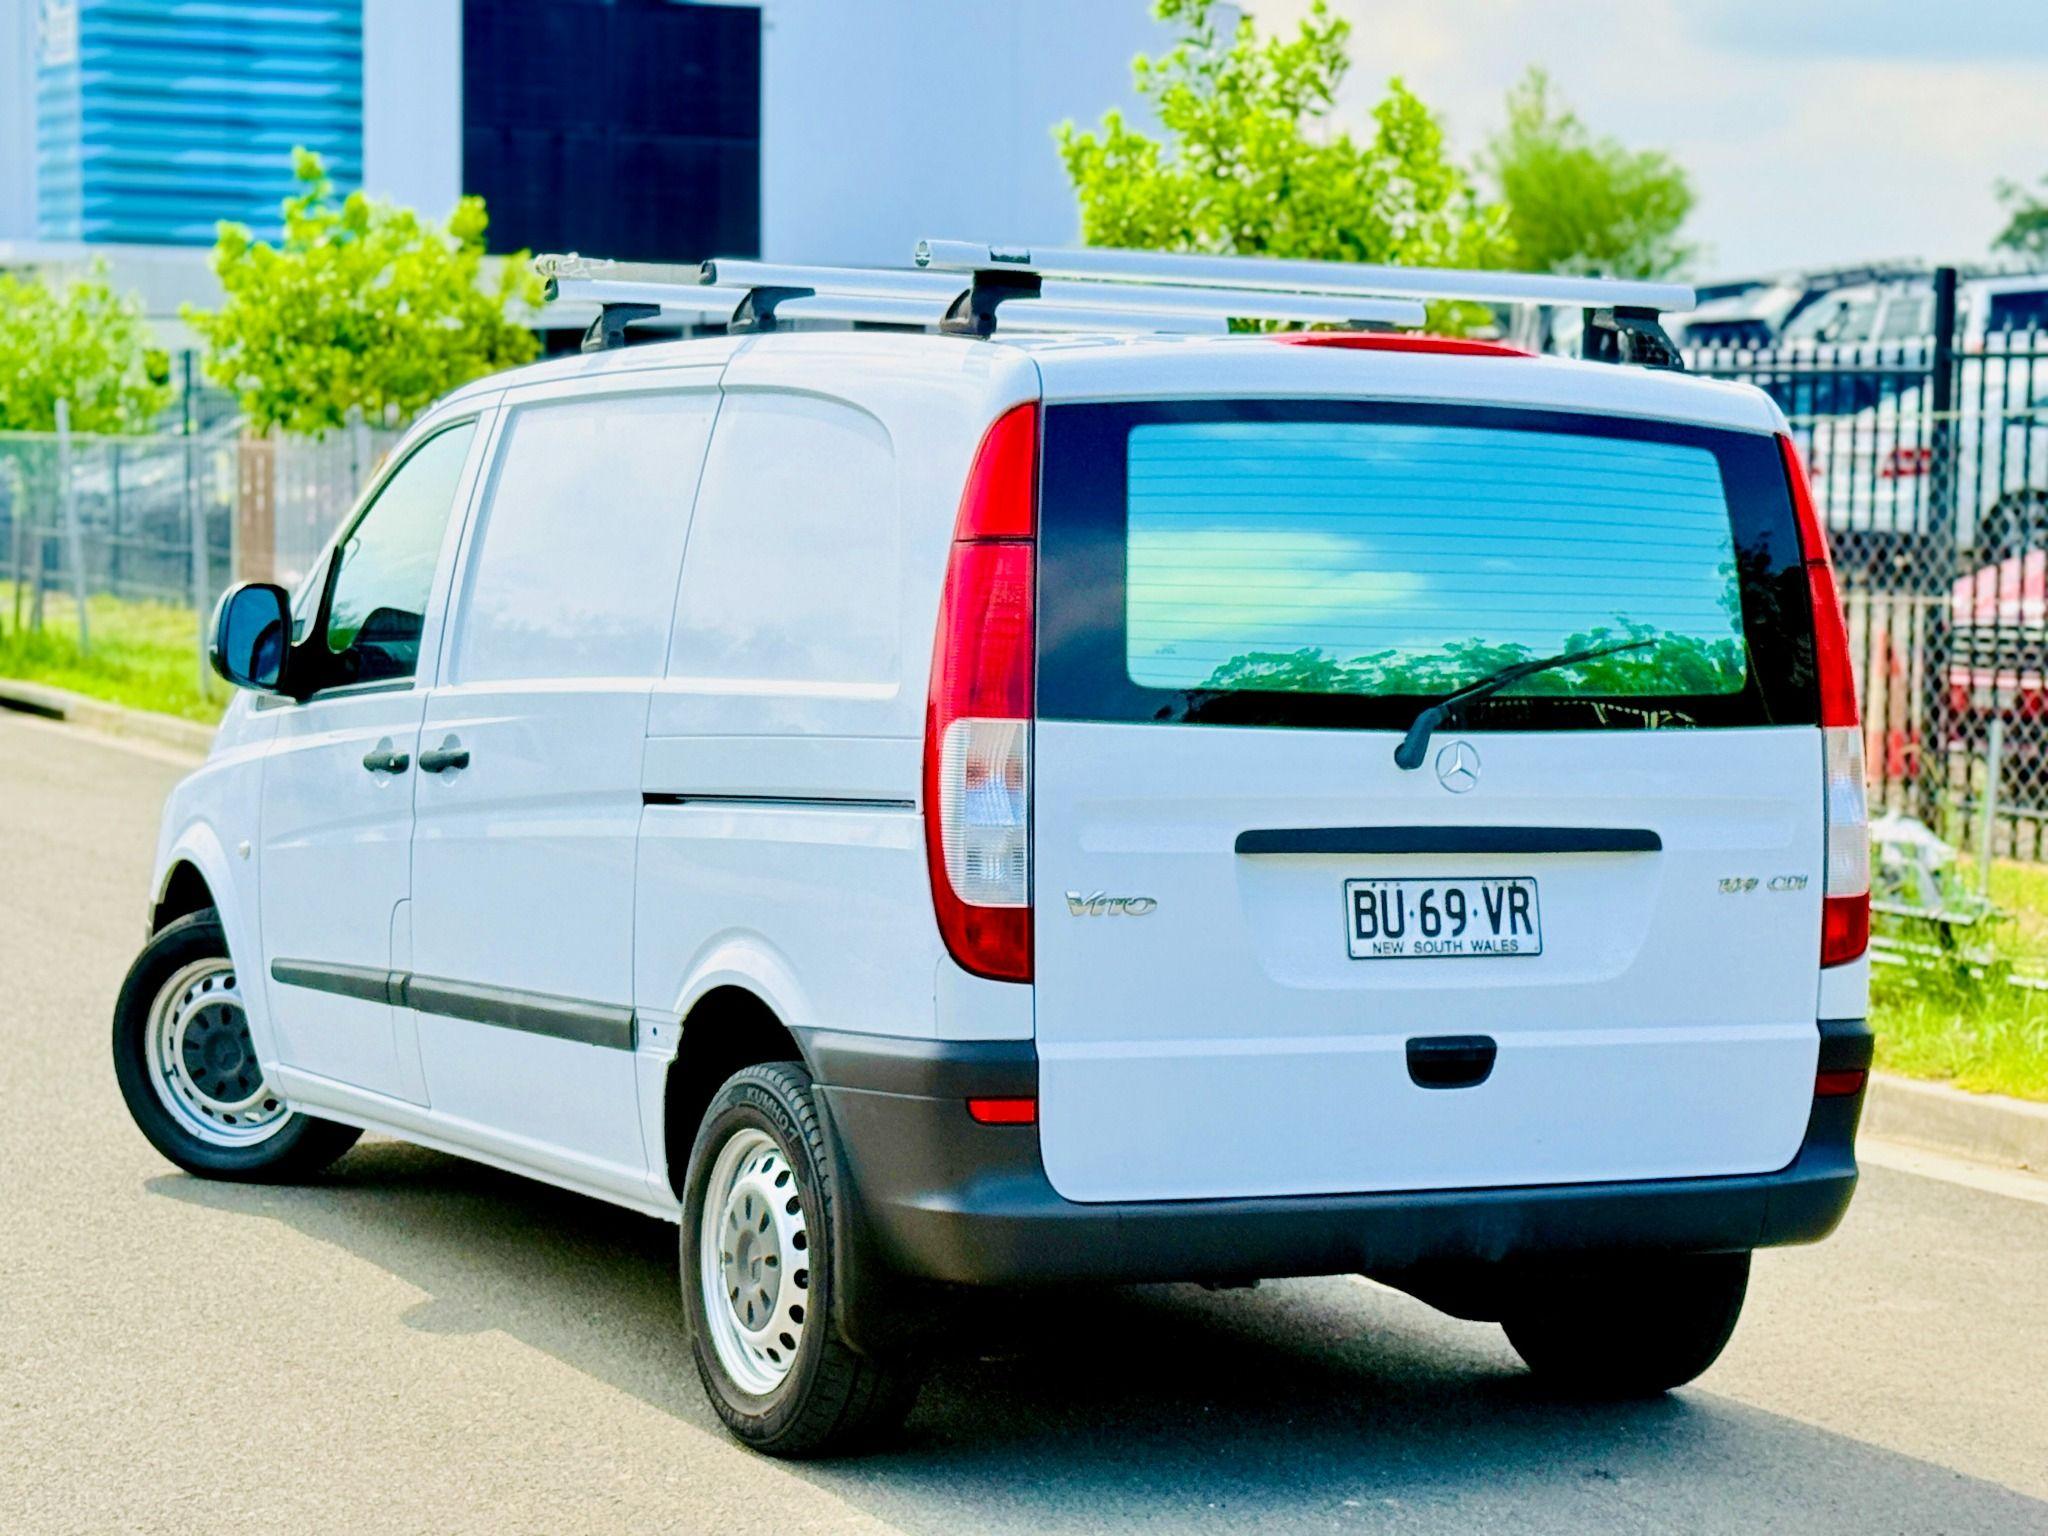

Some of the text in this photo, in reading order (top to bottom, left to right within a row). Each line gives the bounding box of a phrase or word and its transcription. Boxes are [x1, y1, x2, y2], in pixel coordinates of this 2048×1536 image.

[1372, 939, 1519, 955] NEW SOUTH WALES
[746, 1087, 789, 1130] KUMHO
